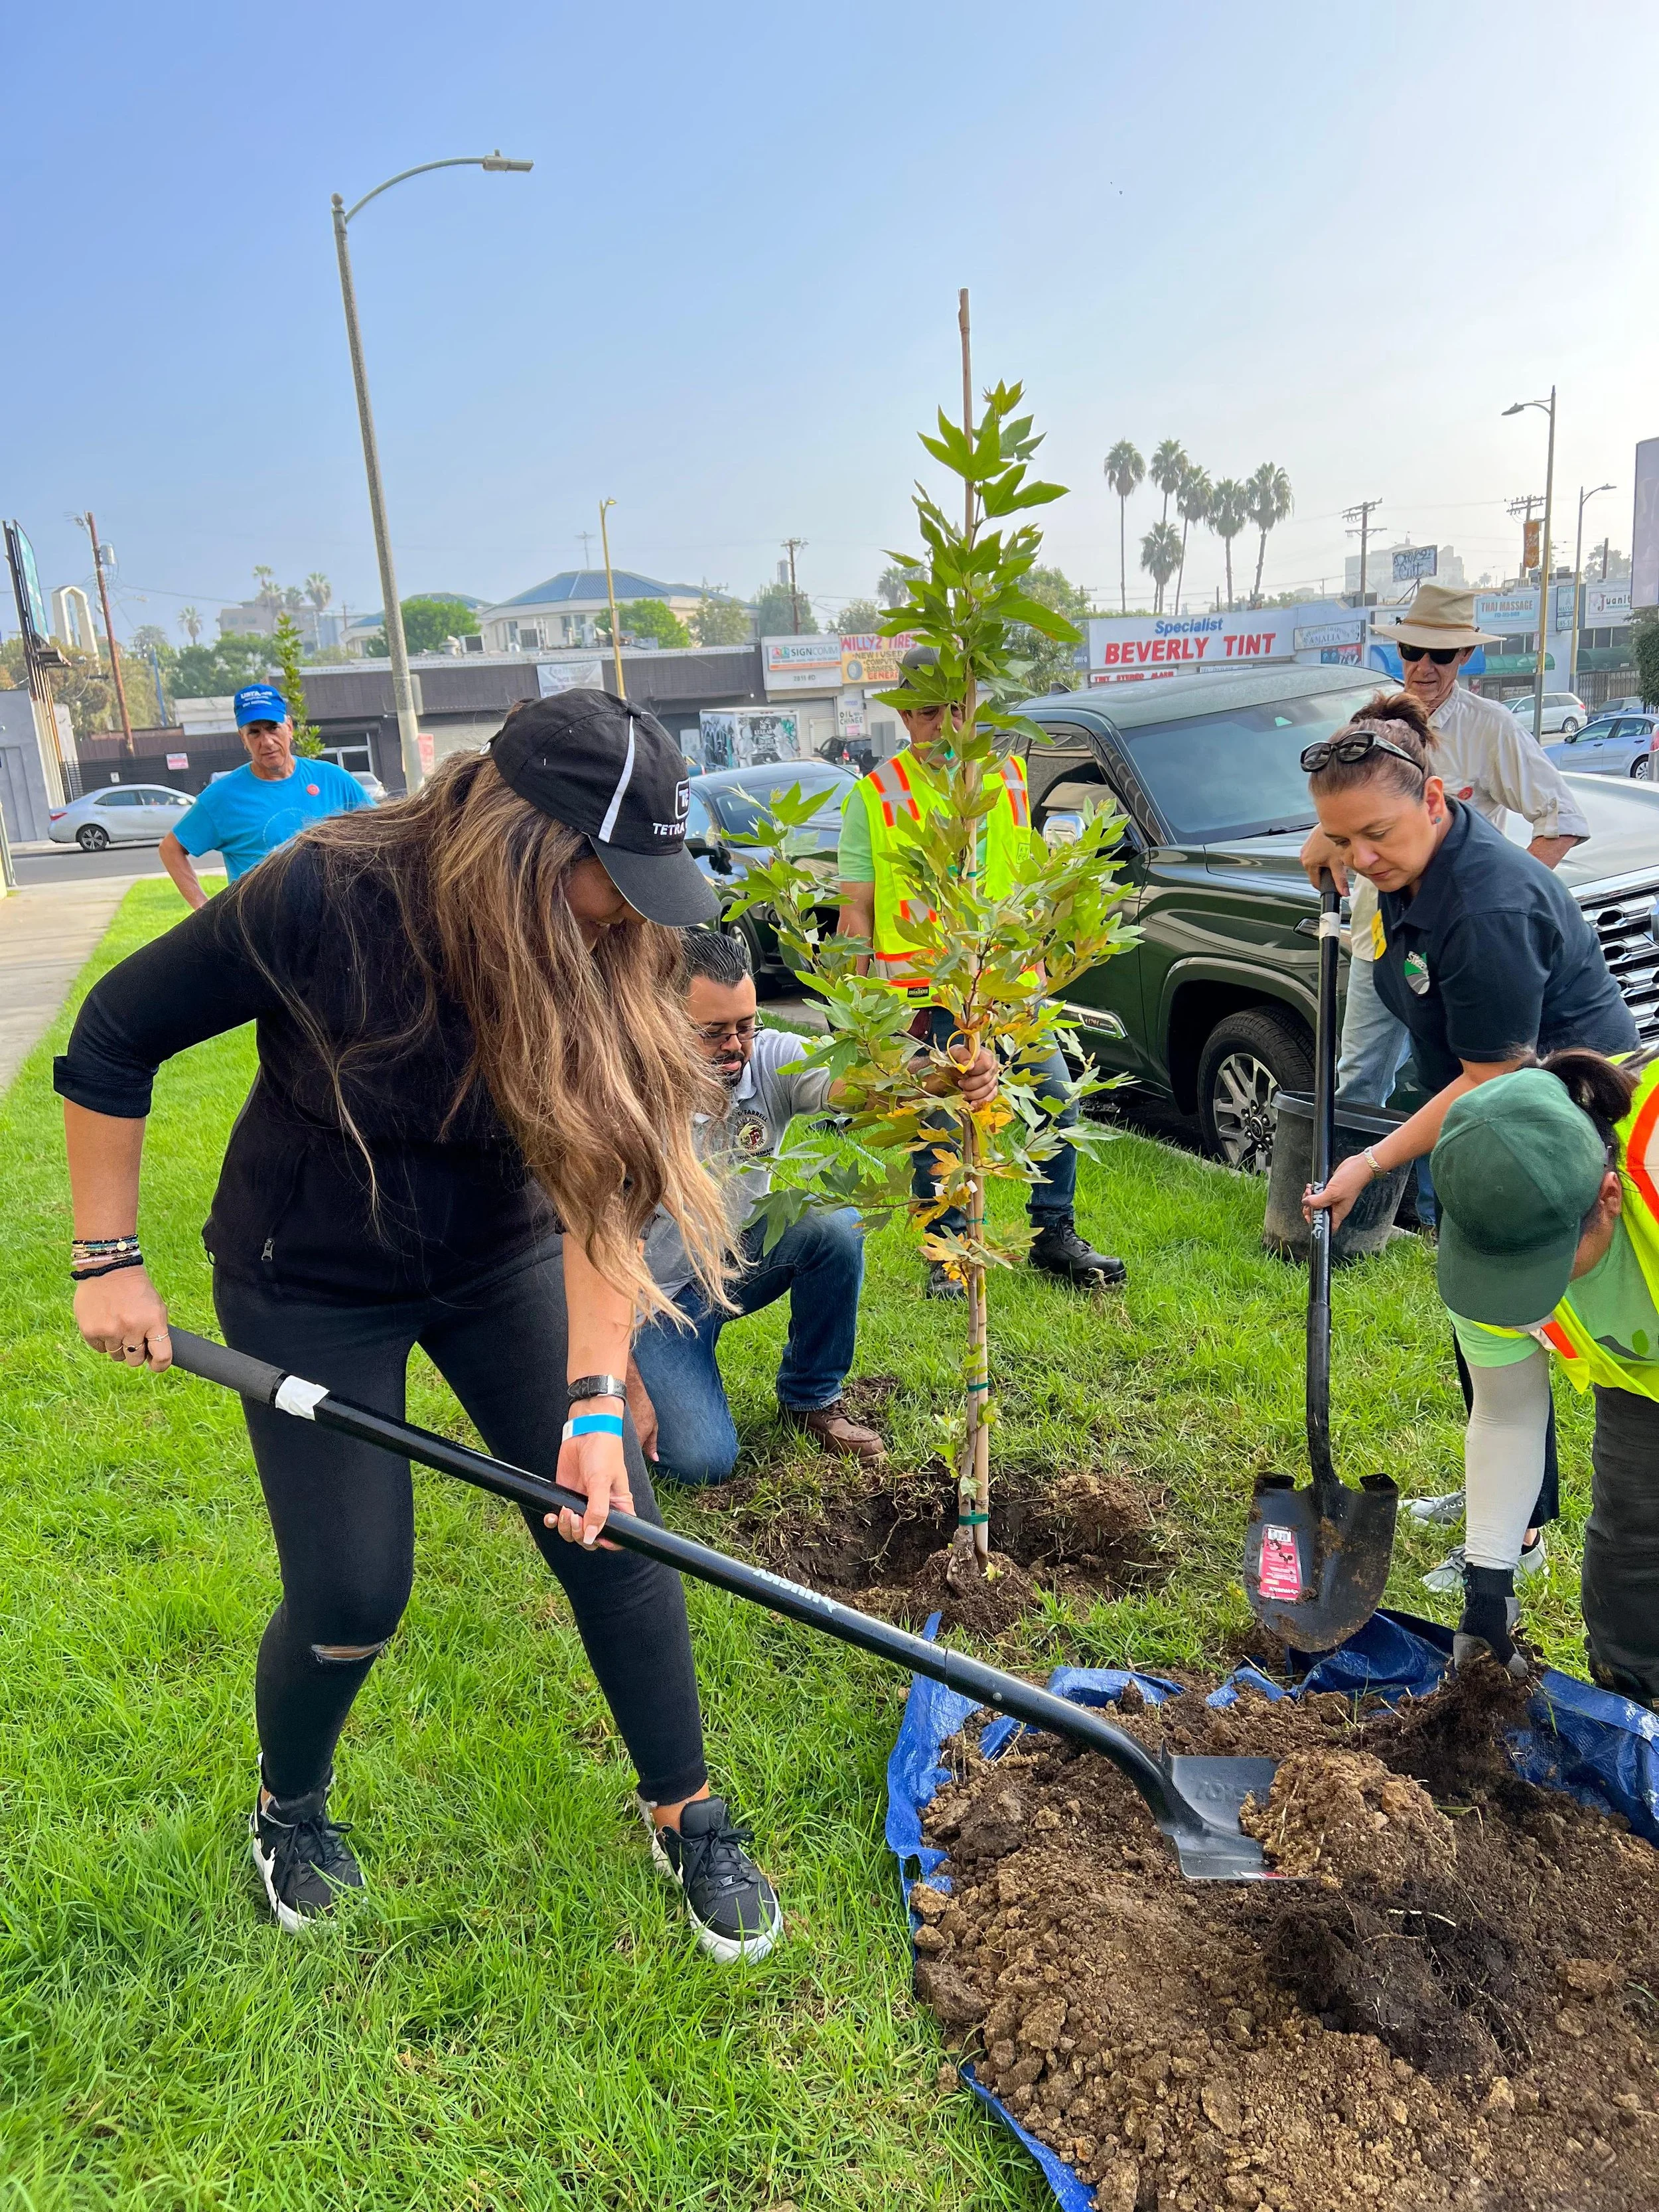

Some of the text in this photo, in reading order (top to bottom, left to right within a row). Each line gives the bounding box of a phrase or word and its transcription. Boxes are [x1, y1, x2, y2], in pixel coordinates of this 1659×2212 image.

[1481, 600, 1533, 612] THAI MASSAGE
[1155, 617, 1224, 636] Specialist
[791, 646, 838, 656] SIGNCOMM
[1105, 632, 1276, 664] BEVERLY TINT
[652, 822, 685, 836] TETRA
[753, 1567, 822, 1604] HUSKY
